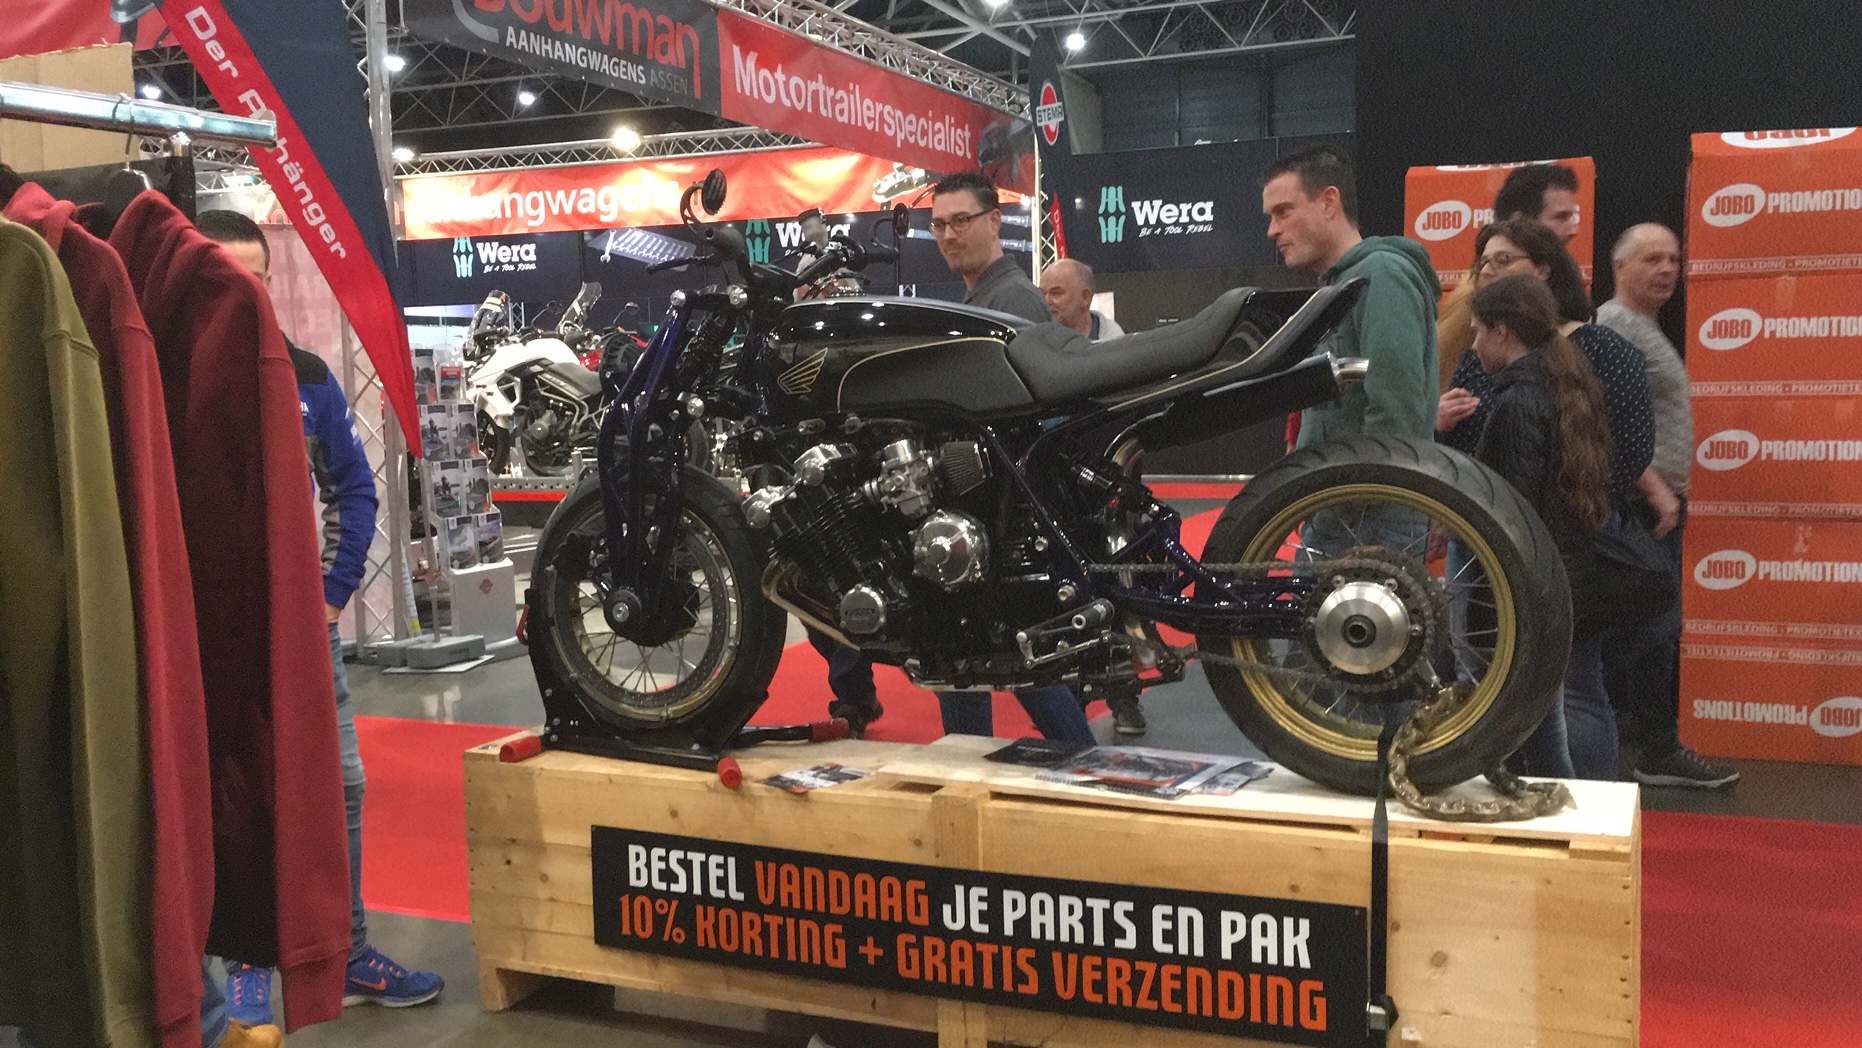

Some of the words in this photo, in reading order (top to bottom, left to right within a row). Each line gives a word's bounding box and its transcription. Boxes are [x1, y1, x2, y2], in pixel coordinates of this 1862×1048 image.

[474, 0, 702, 99] ouwman
[506, 26, 646, 85] AANHANGWAGENS
[651, 69, 688, 96] ASSEN
[732, 44, 972, 159] Motortrailerspecialist
[1037, 106, 1064, 125] STEMA
[185, 5, 239, 78] Der
[238, 89, 346, 259] Ahänger
[1131, 199, 1214, 226] Wera
[1710, 193, 1755, 217] JOBO
[1422, 210, 1462, 231] JOBO
[476, 242, 537, 264] Wera
[1707, 318, 1752, 340] JOBO
[1704, 440, 1750, 460] JOBO
[1702, 560, 1747, 580] JOBO
[1693, 699, 1808, 726] PROMOTIONS
[628, 844, 745, 901] BESTEL
[754, 859, 930, 926] VANDAAG
[942, 884, 989, 934] JE
[1002, 889, 1137, 950] PARTS
[1151, 904, 1204, 957] EN
[1220, 910, 1311, 969] PAK
[619, 893, 686, 945] 10%
[696, 903, 847, 969] KORTING
[858, 935, 884, 965] +
[896, 932, 1039, 996] GRATIS
[1052, 950, 1328, 1032] VERZENDING
